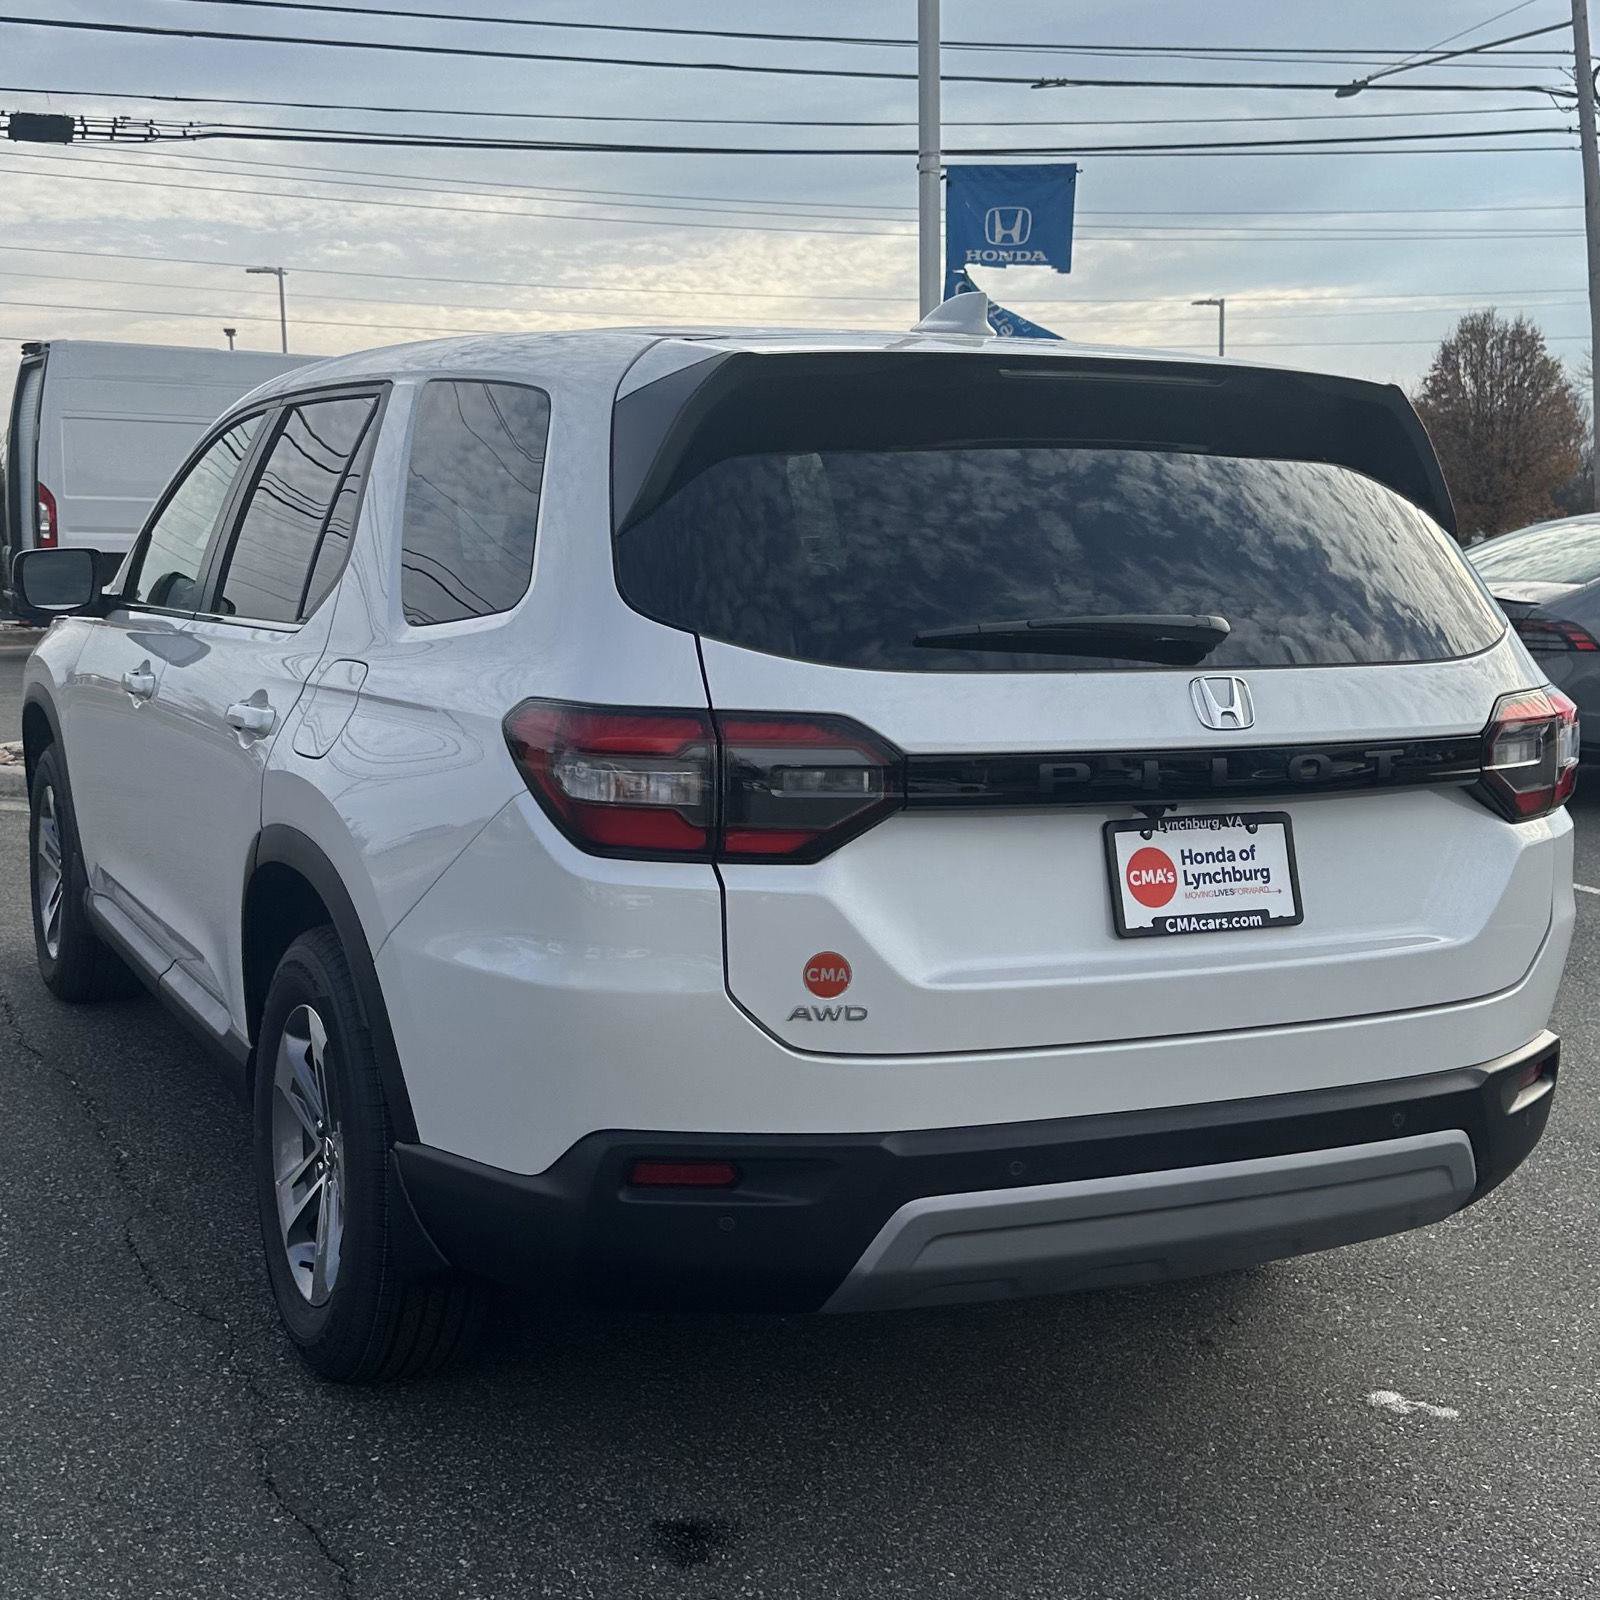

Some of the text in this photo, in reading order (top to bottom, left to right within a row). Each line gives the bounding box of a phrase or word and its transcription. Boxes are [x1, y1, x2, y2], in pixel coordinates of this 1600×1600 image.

[966, 250, 1048, 262] HONDA
[1038, 748, 1404, 792] PILOT
[1227, 815, 1243, 828] VA
[1180, 844, 1256, 866] Honda of
[1129, 868, 1175, 886] CMA's
[1184, 866, 1271, 889] Lynchburg
[1165, 915, 1263, 933] CMAcars.com
[806, 967, 848, 982] CMA
[786, 1005, 868, 1022] AWD
